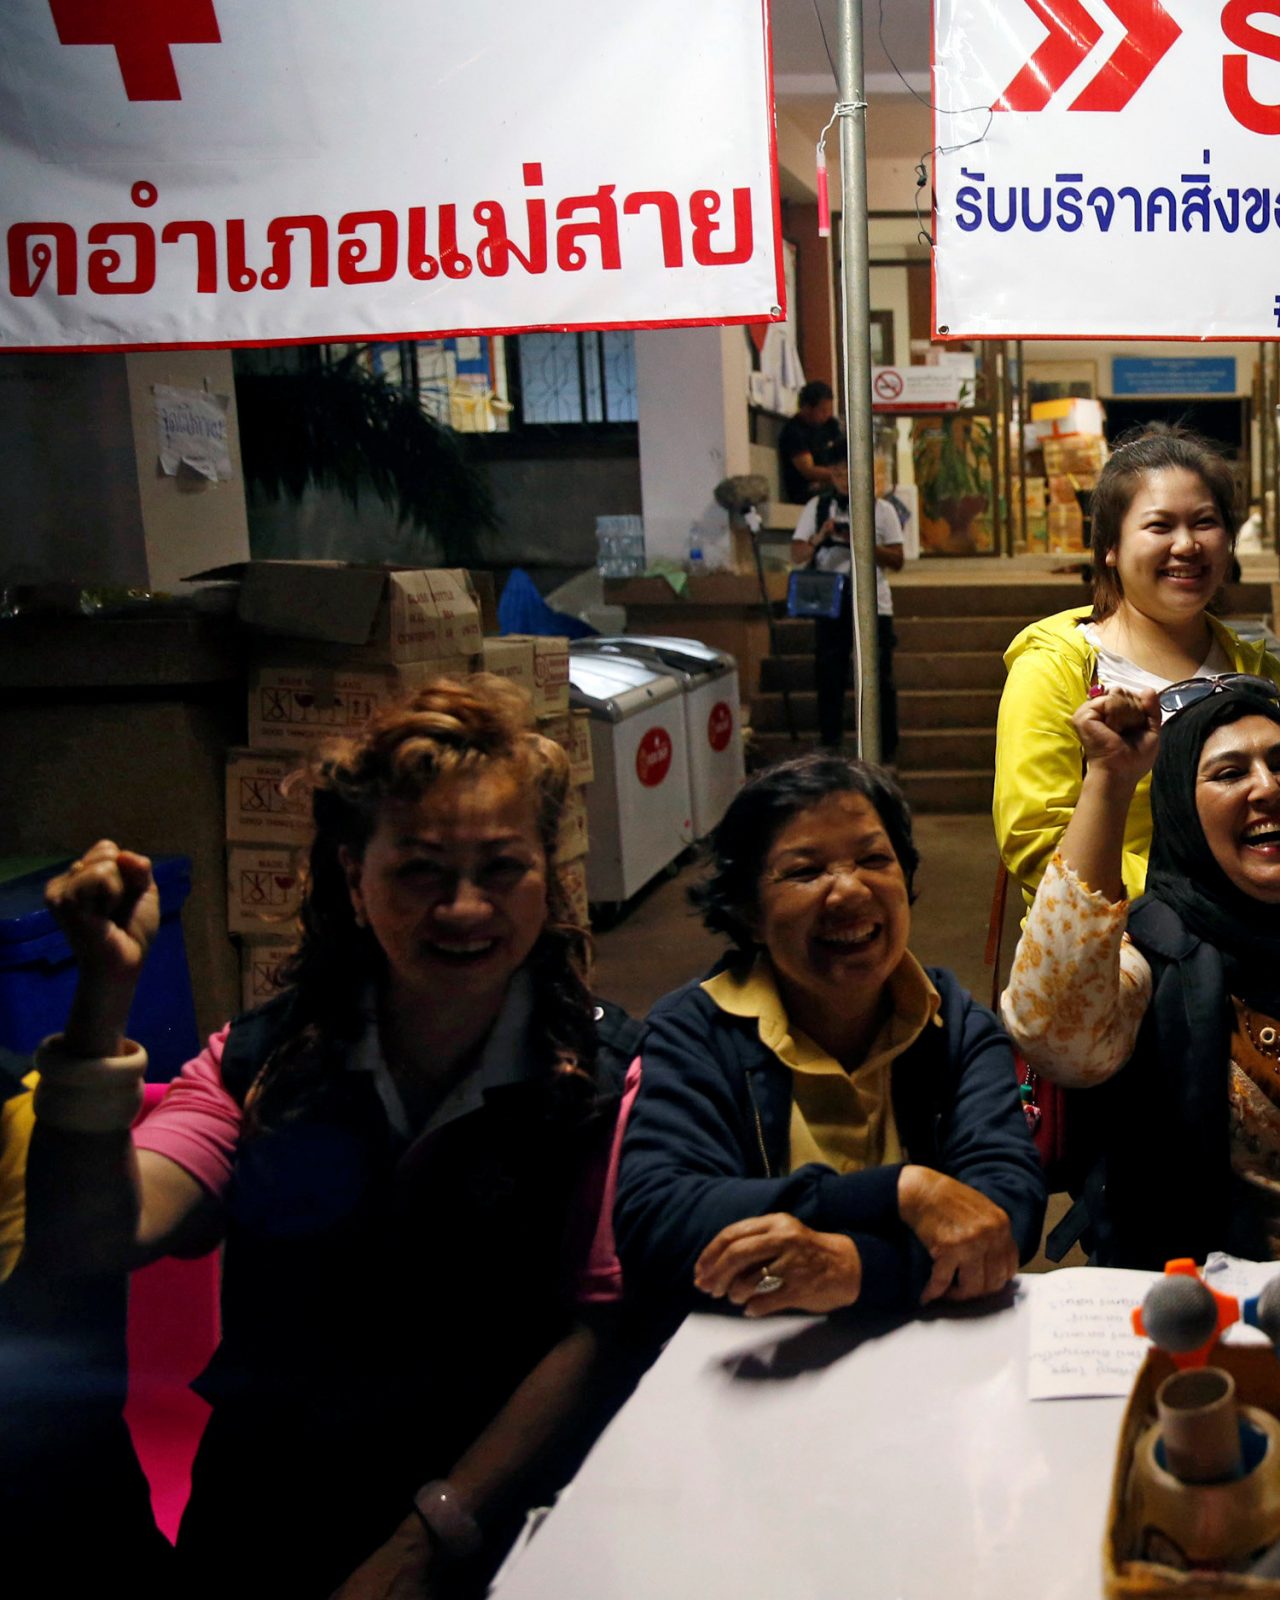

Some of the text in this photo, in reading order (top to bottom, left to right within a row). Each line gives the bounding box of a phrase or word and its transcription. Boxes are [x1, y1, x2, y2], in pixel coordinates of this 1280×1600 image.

[7, 161, 753, 298] ดอำเภอแม่สาย
